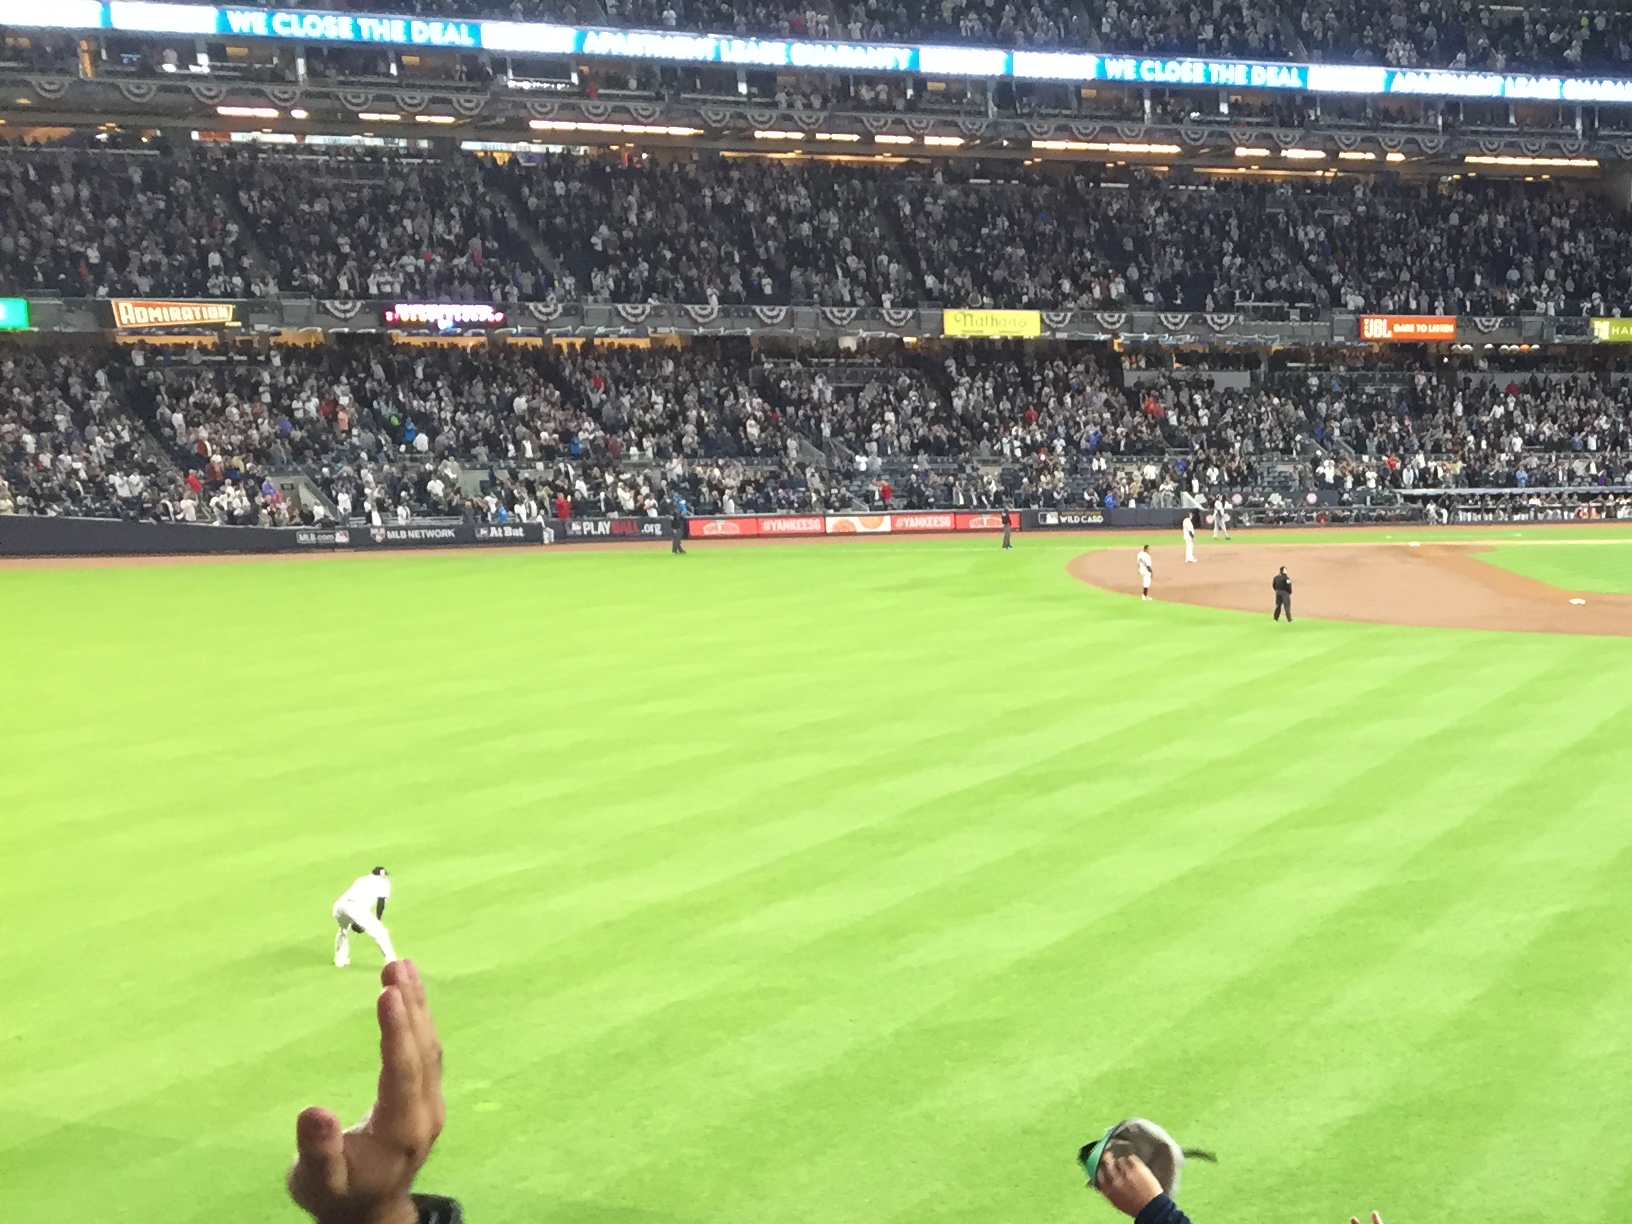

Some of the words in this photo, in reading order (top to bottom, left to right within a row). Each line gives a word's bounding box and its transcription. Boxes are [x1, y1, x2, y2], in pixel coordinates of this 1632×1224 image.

[227, 10, 267, 35] WE
[272, 13, 355, 39] CLOSE
[357, 17, 406, 42] THE
[410, 20, 475, 46] DEAL
[1105, 58, 1136, 80] WE
[1140, 60, 1206, 83] CLOSE
[1208, 63, 1249, 85] THE
[1250, 66, 1303, 88] DEAL
[119, 302, 229, 324] ADMIRATION
[1366, 318, 1390, 338] JBL
[1060, 515, 1080, 524] WILD
[1081, 515, 1104, 524] CARD
[387, 530, 406, 539] MLB
[408, 528, 456, 538] NETWORK
[490, 526, 503, 537] At
[504, 525, 524, 537] Bat
